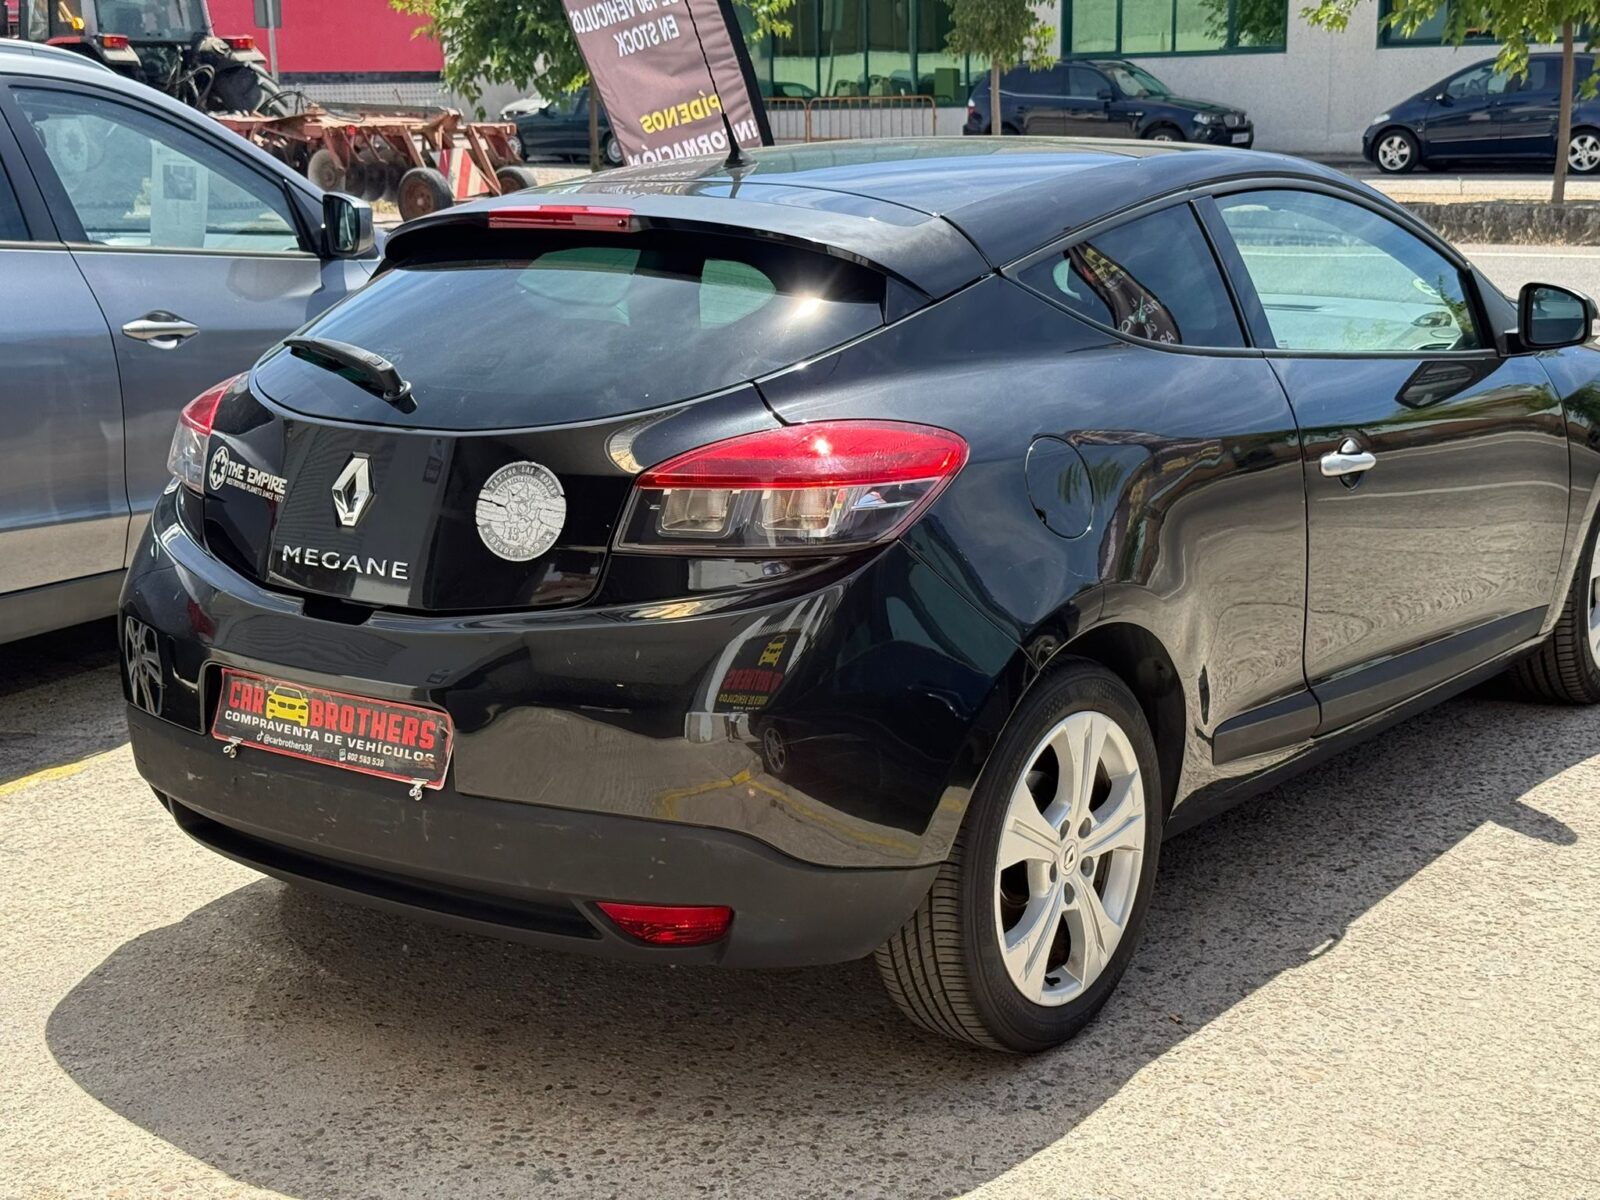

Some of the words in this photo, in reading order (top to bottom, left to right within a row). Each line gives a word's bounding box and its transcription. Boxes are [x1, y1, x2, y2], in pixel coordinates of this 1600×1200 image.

[228, 460, 246, 480] THE
[247, 467, 288, 495] EMPIRE
[282, 545, 409, 580] MEGANE
[227, 681, 265, 715] CAR
[309, 699, 436, 749] BROTHERS
[225, 710, 320, 741] COMPRAVENTA
[324, 733, 342, 745] DE
[347, 737, 435, 762] VEHÍCULOS
[262, 735, 313, 753] @carbrothers38
